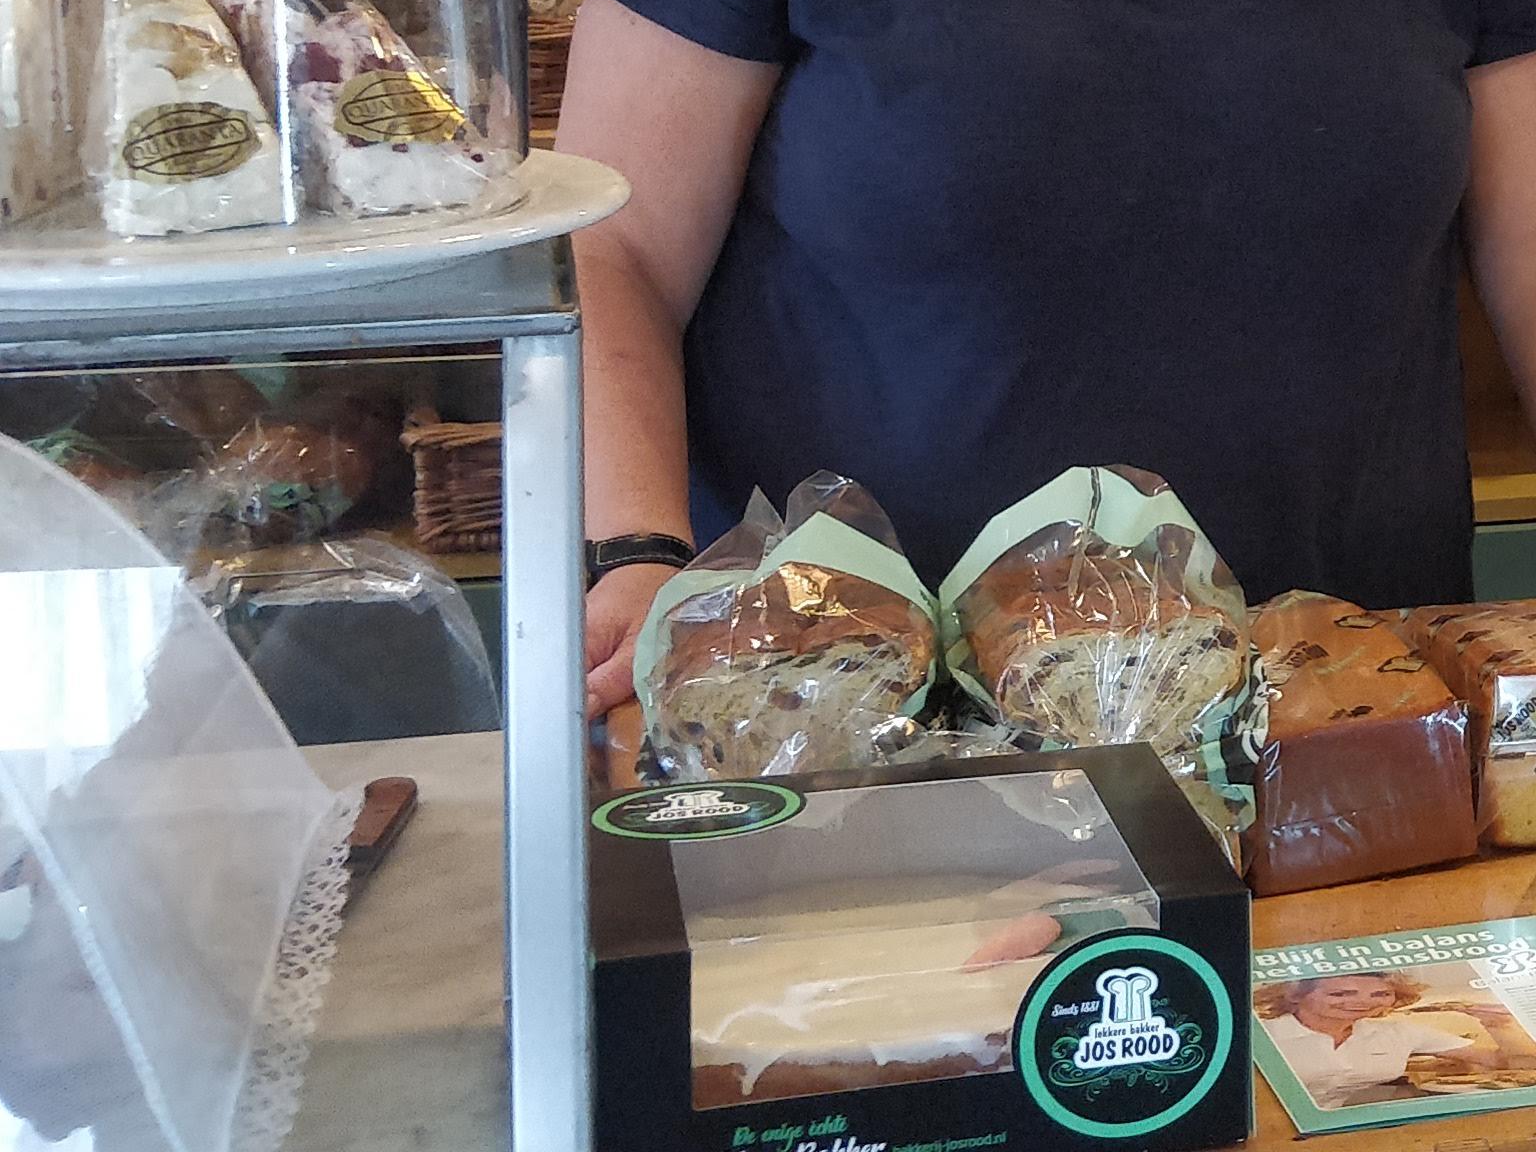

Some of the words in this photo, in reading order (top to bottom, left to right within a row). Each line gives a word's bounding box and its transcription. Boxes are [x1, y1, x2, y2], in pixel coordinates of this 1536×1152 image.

[653, 810, 687, 820] JOS
[692, 805, 744, 817] ROOD
[1255, 948, 1327, 966] Blijf
[1336, 945, 1372, 958] in
[1380, 929, 1495, 953] balans
[1312, 937, 1530, 973] Balansbrood
[1130, 1023, 1160, 1035] bakker
[1080, 1041, 1116, 1063] JOS
[1122, 1033, 1174, 1058] ROOD
[795, 1135, 888, 1152] Bkker
